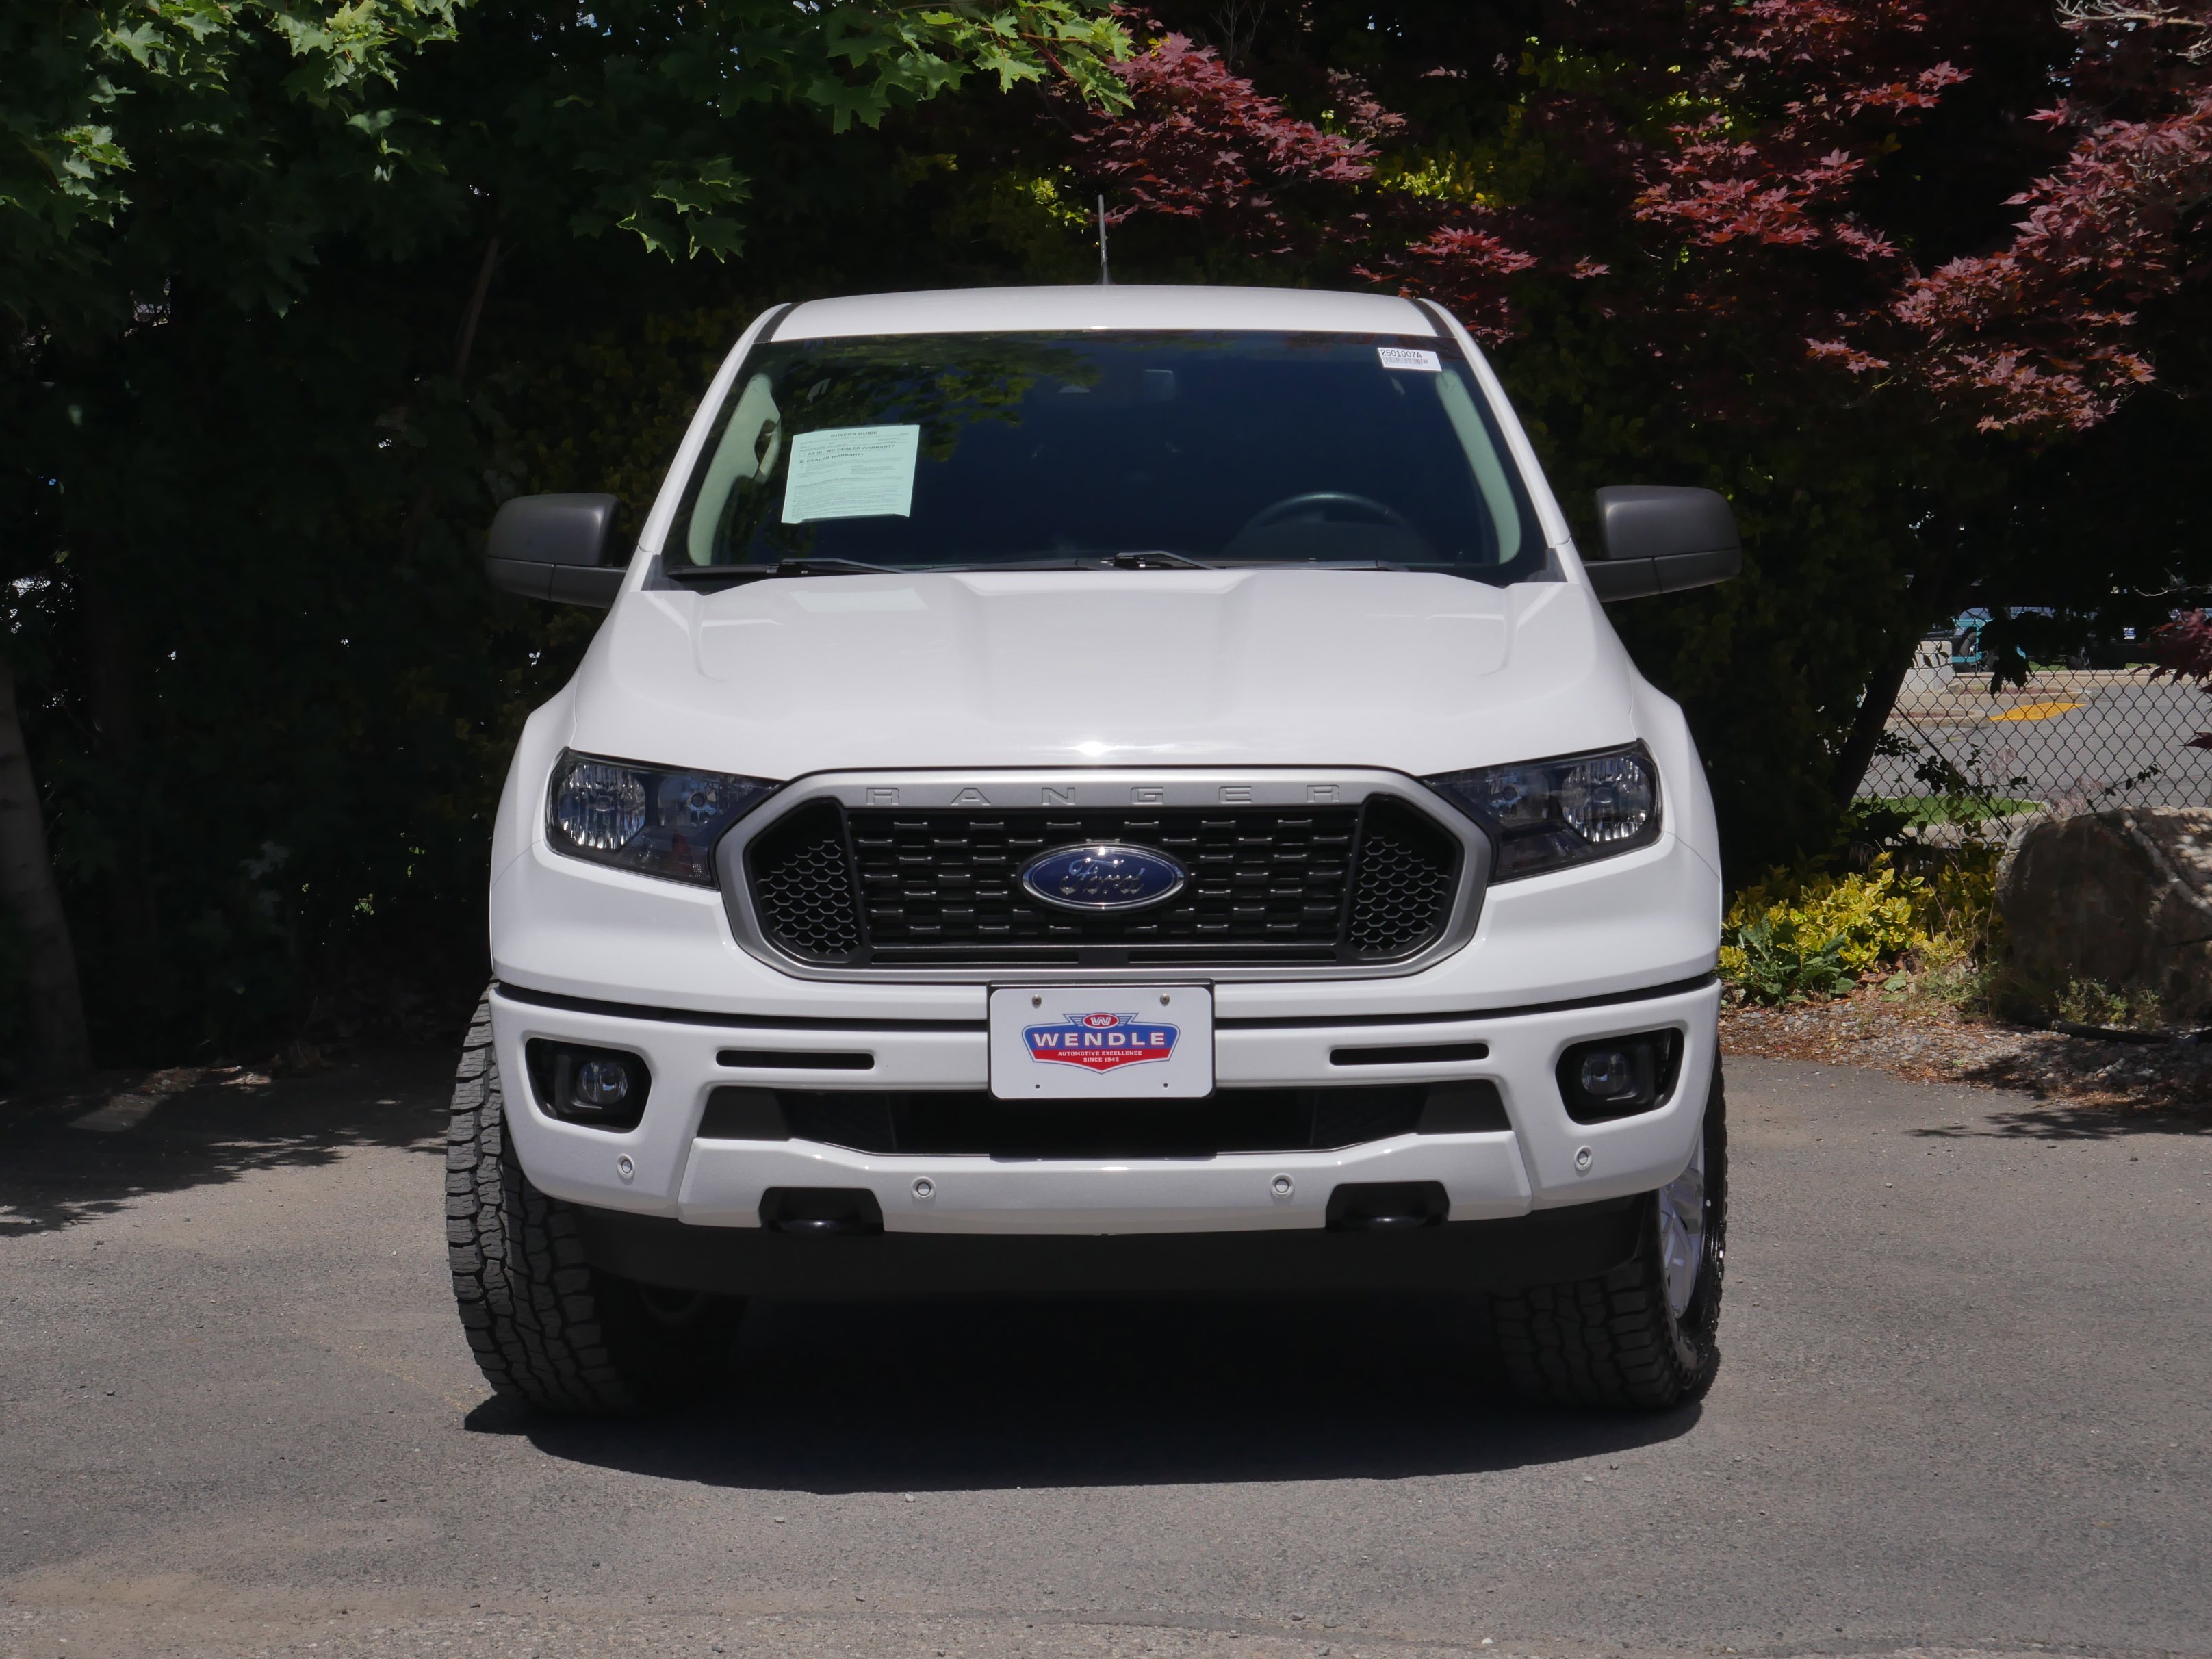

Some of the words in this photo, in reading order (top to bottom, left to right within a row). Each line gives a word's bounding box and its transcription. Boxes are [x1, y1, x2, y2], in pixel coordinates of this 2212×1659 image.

[1380, 349, 1423, 359] 2501007A
[866, 784, 1340, 806] RANGER
[1059, 858, 1146, 895] Ford
[1033, 1032, 1165, 1046] WENDLE
